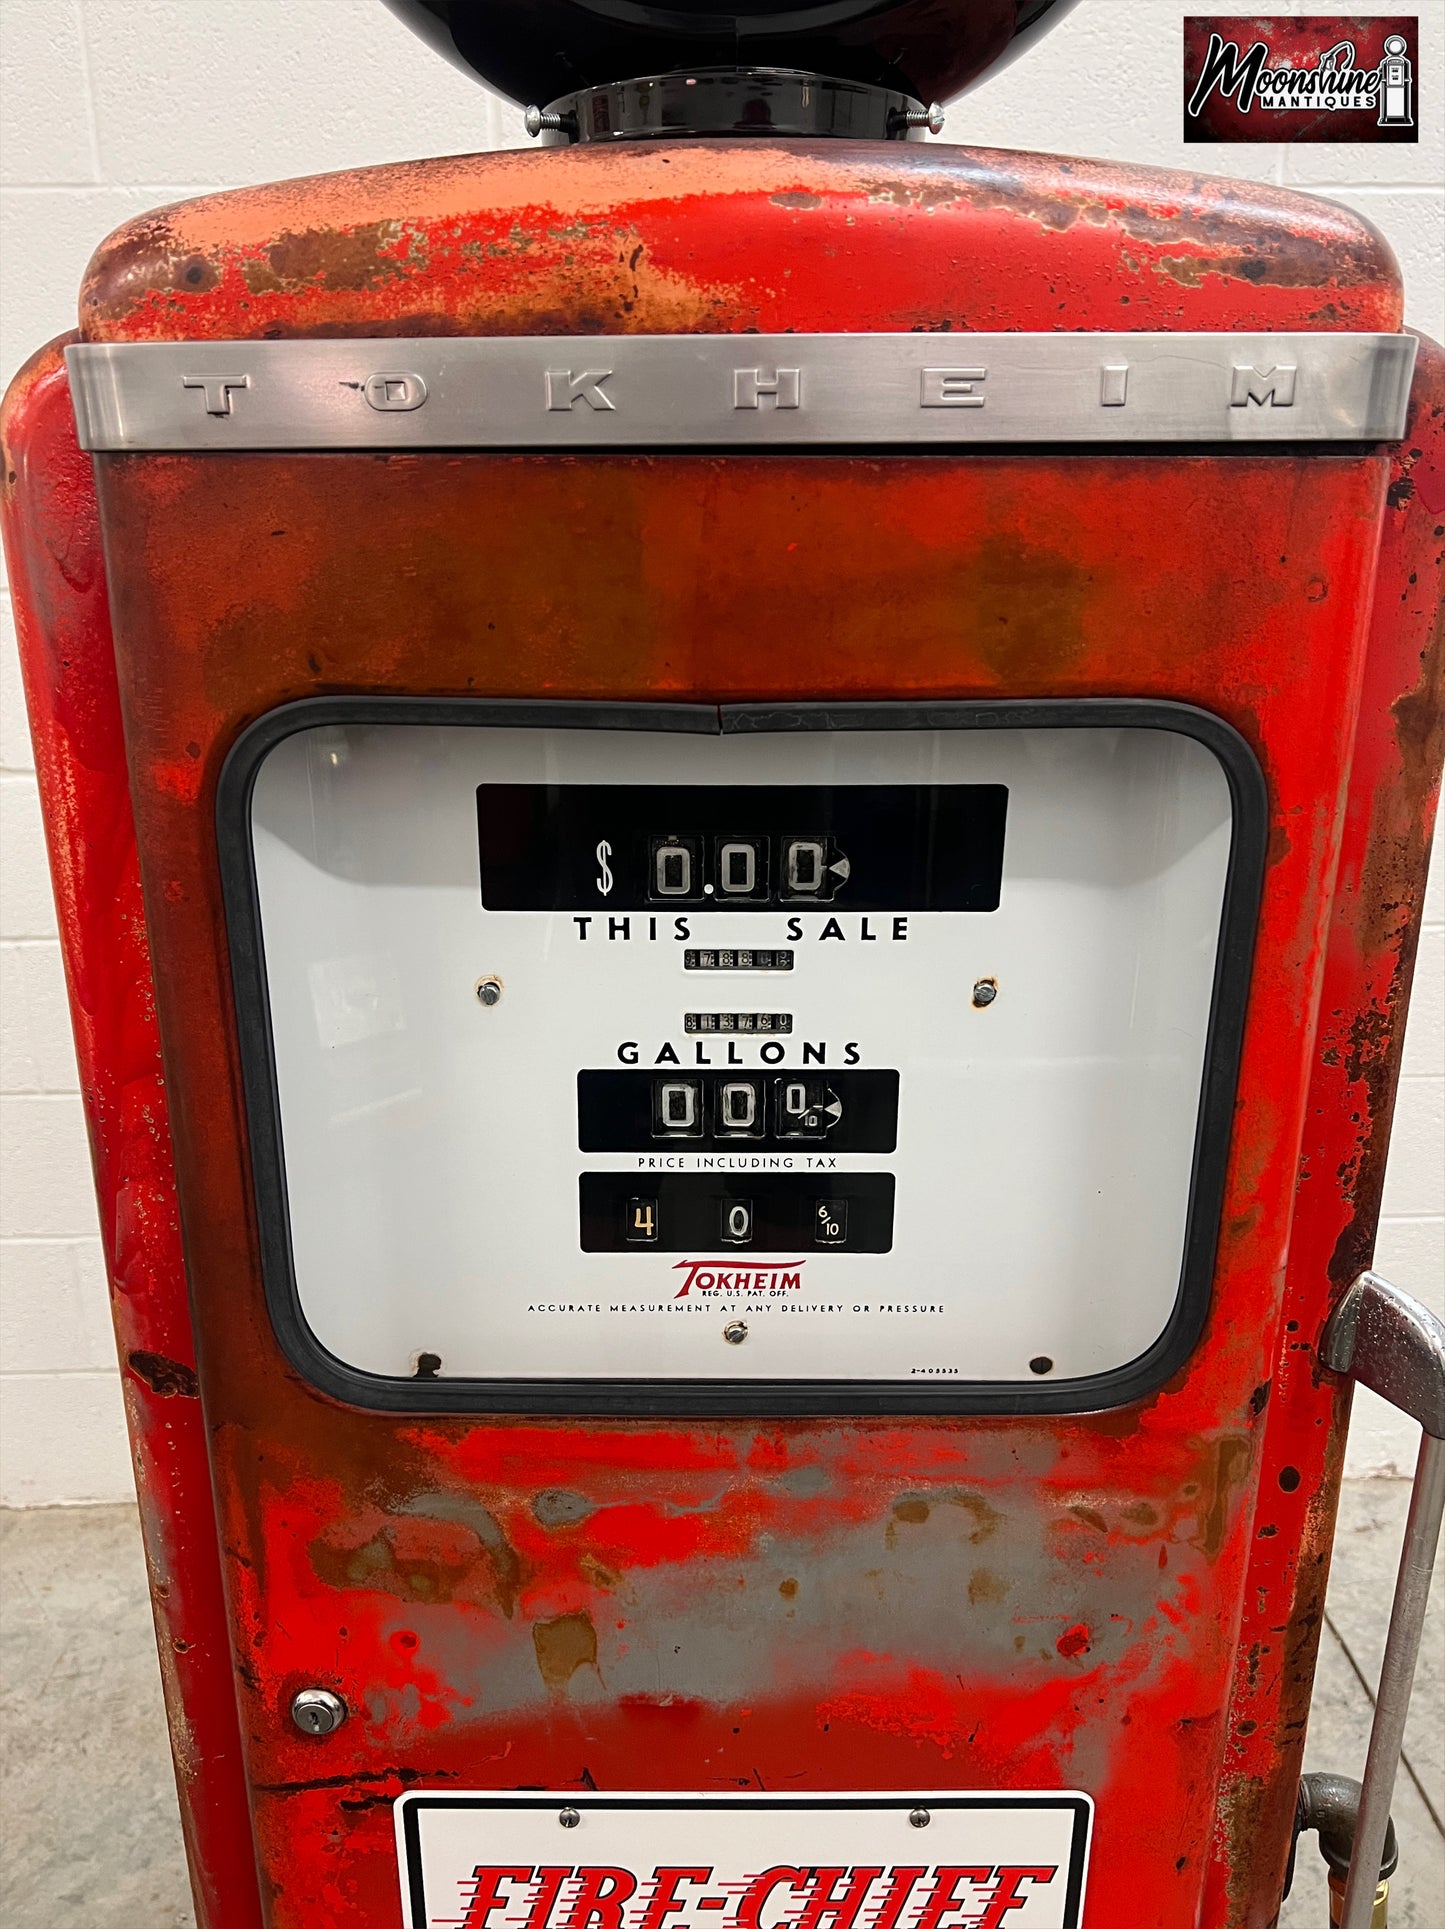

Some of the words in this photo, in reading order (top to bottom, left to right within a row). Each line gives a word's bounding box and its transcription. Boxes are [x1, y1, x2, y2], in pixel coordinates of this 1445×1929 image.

[183, 364, 1298, 416] TOKHEIM
[573, 916, 691, 941] THIS
[786, 917, 908, 942] SALE
[616, 1041, 862, 1066] GALLONS
[638, 1157, 685, 1168] PRICE
[697, 1157, 794, 1169] INCLUDING
[806, 1157, 838, 1169] TAX
[672, 1259, 807, 1299] TOKHEIM
[527, 1304, 601, 1313] ACCURATE
[609, 1304, 711, 1313] MEASUREMENT
[720, 1304, 736, 1313] AT
[745, 1304, 773, 1313] ANY
[781, 1304, 843, 1313] DELIVERY
[852, 1304, 870, 1313] OR
[879, 1304, 945, 1313] PRESSURE
[452, 1865, 1060, 1929] FIRE-CHIEF
